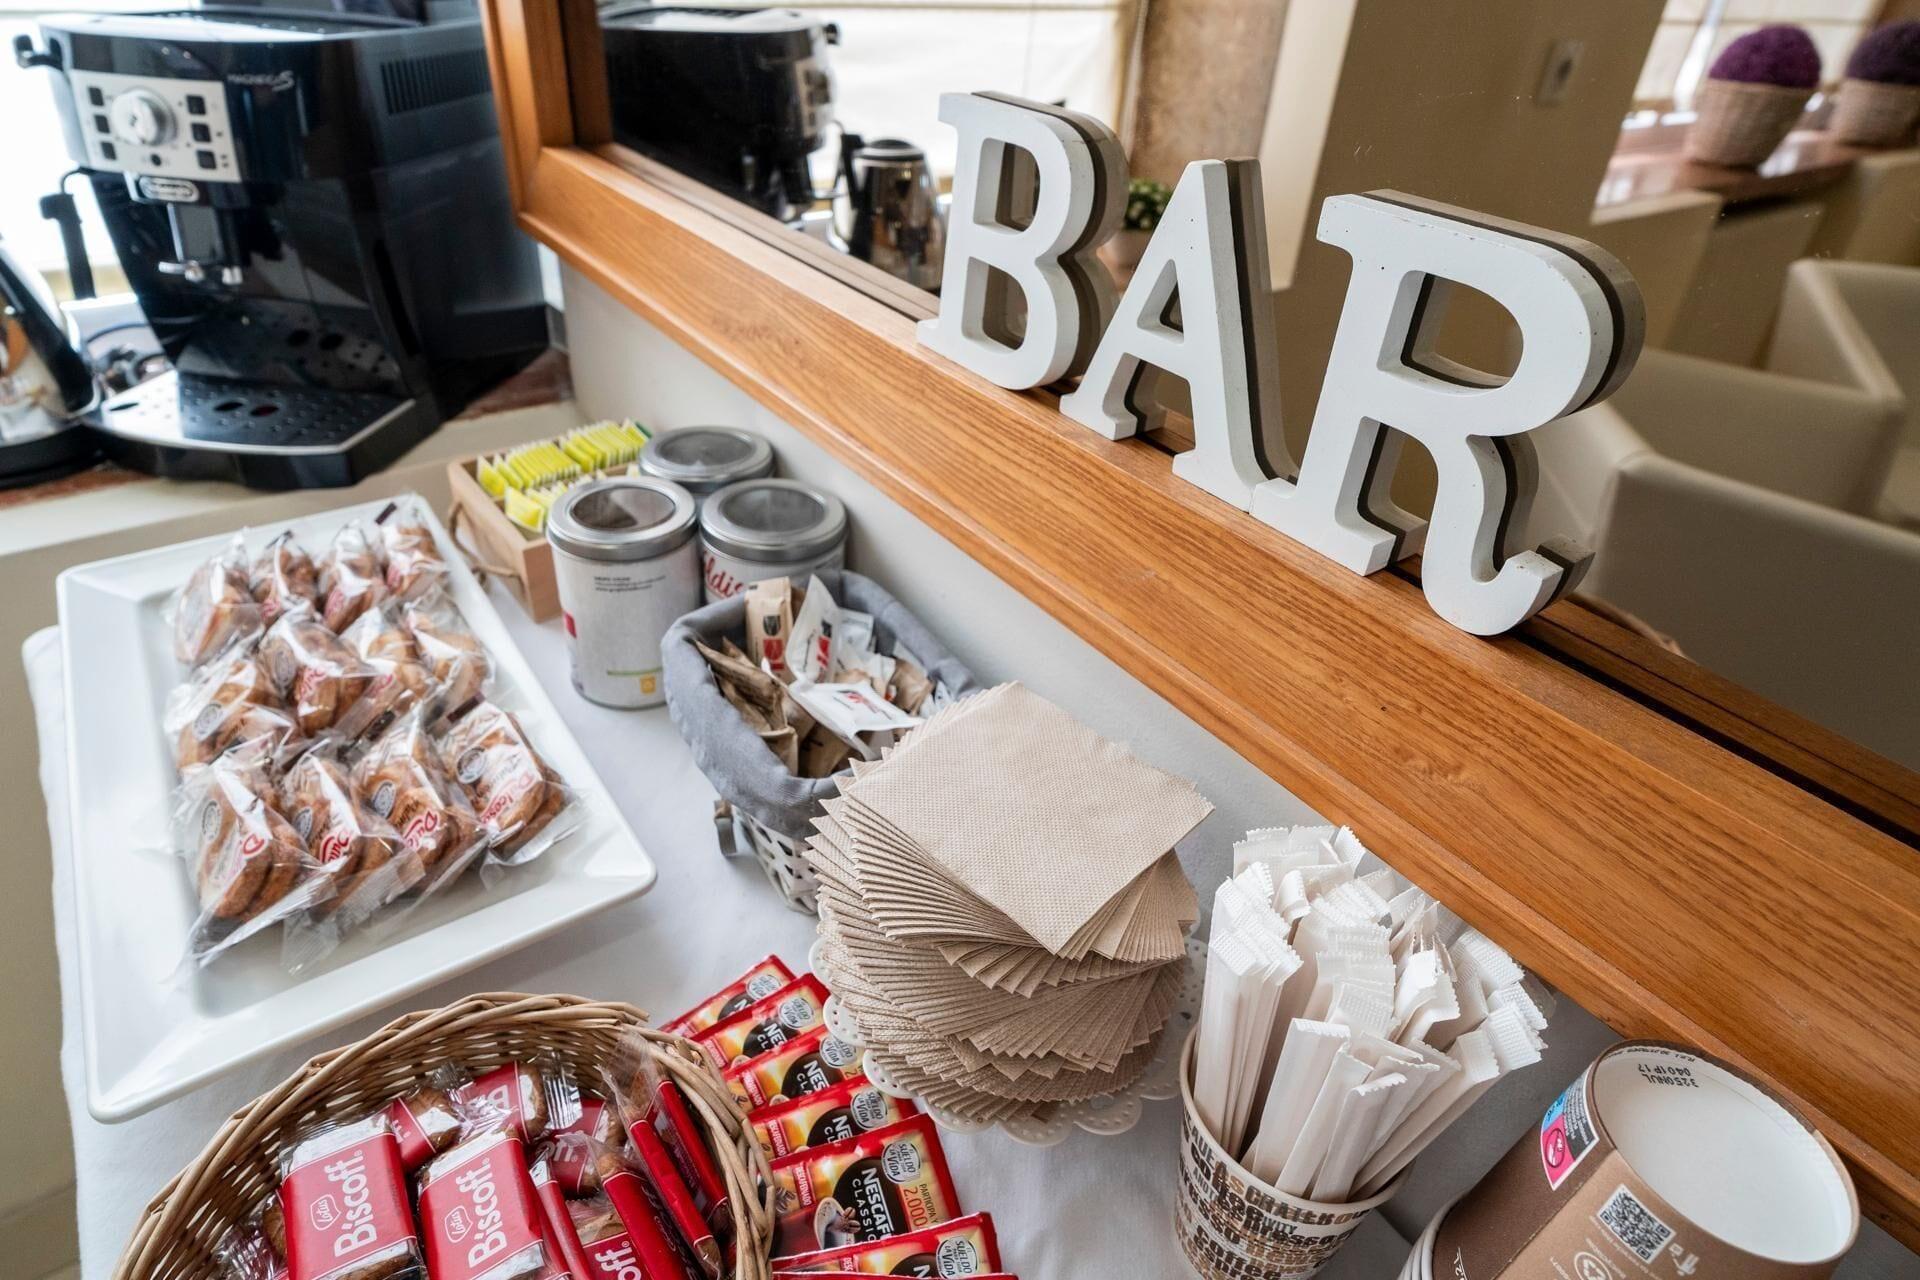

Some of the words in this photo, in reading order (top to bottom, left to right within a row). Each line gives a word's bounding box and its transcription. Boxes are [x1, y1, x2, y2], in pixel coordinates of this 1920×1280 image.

[917, 92, 1613, 636] BAR
[900, 1142, 916, 1174] SUELDO
[324, 1152, 378, 1258] Biscoff
[455, 1161, 508, 1269] Biscoff
[862, 1168, 894, 1236] NESCAF
[919, 1184, 936, 1217] PARTICIPA
[956, 1240, 972, 1273] SUELDO
